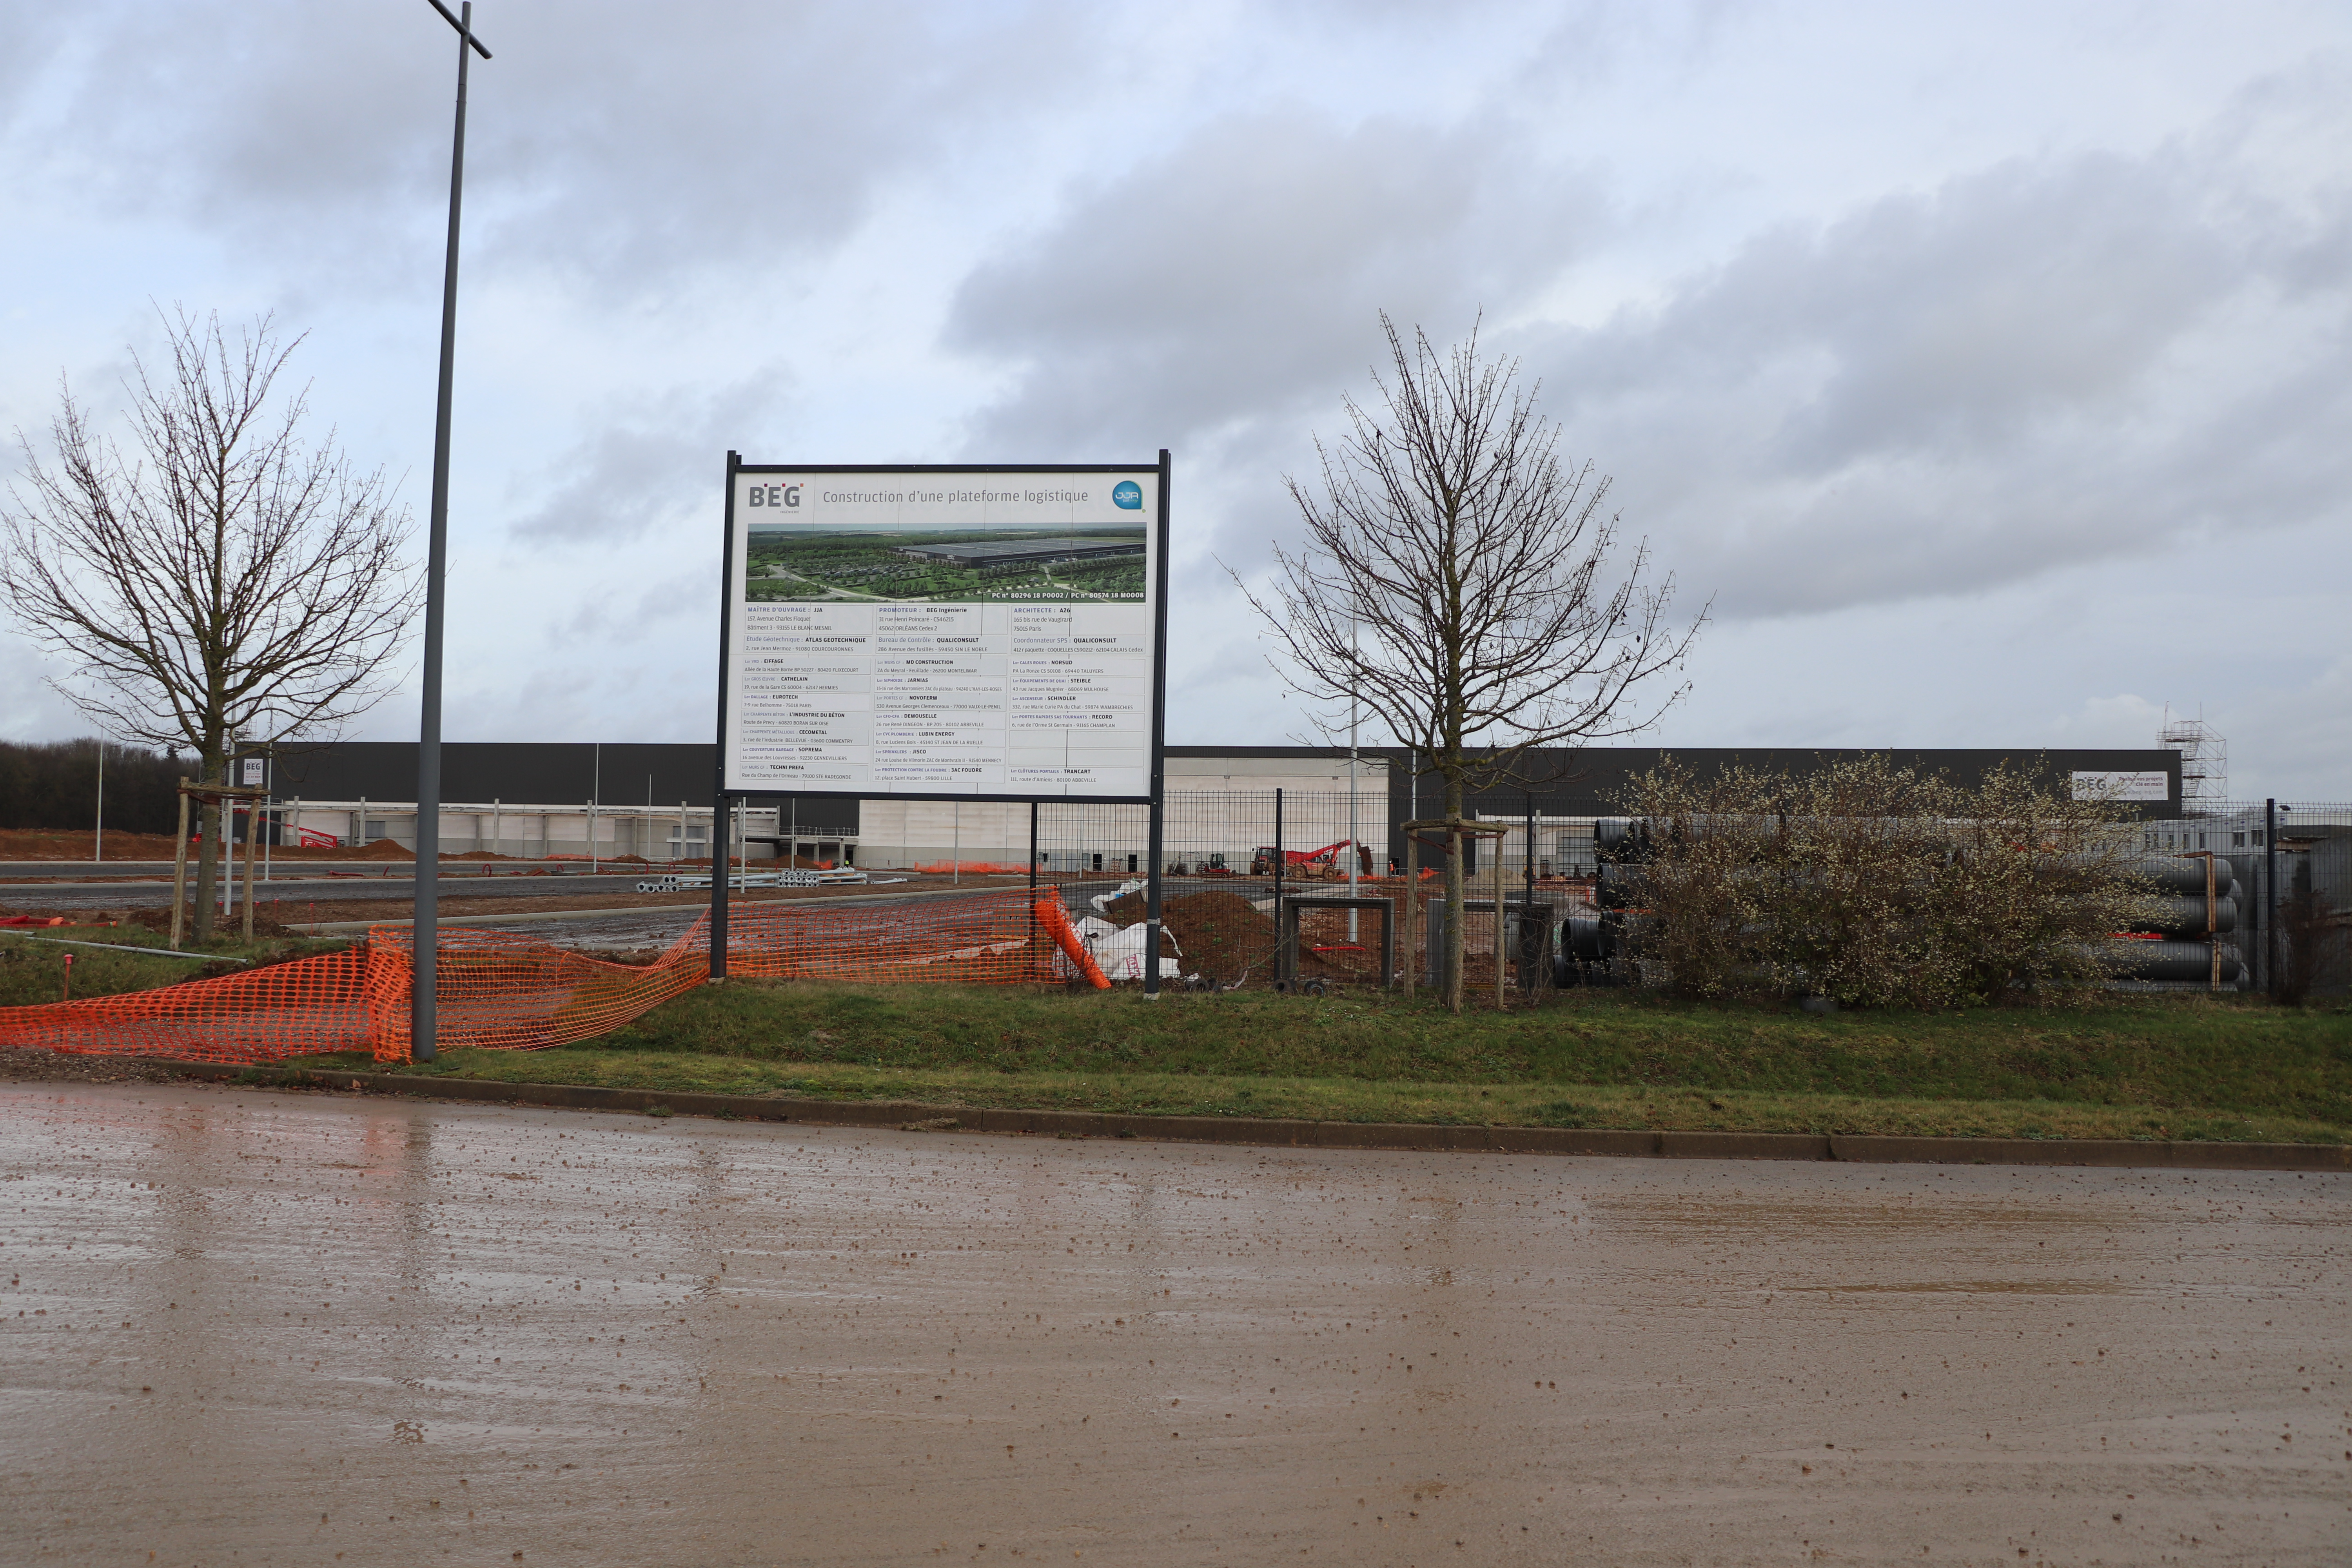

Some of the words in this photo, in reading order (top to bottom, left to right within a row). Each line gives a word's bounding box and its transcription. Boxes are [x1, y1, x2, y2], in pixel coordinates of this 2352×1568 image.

[750, 486, 800, 507] BEG
[823, 490, 902, 503] Construction
[909, 491, 943, 502] d'une
[949, 490, 1020, 504] plateforme
[1025, 489, 1088, 504] logistique
